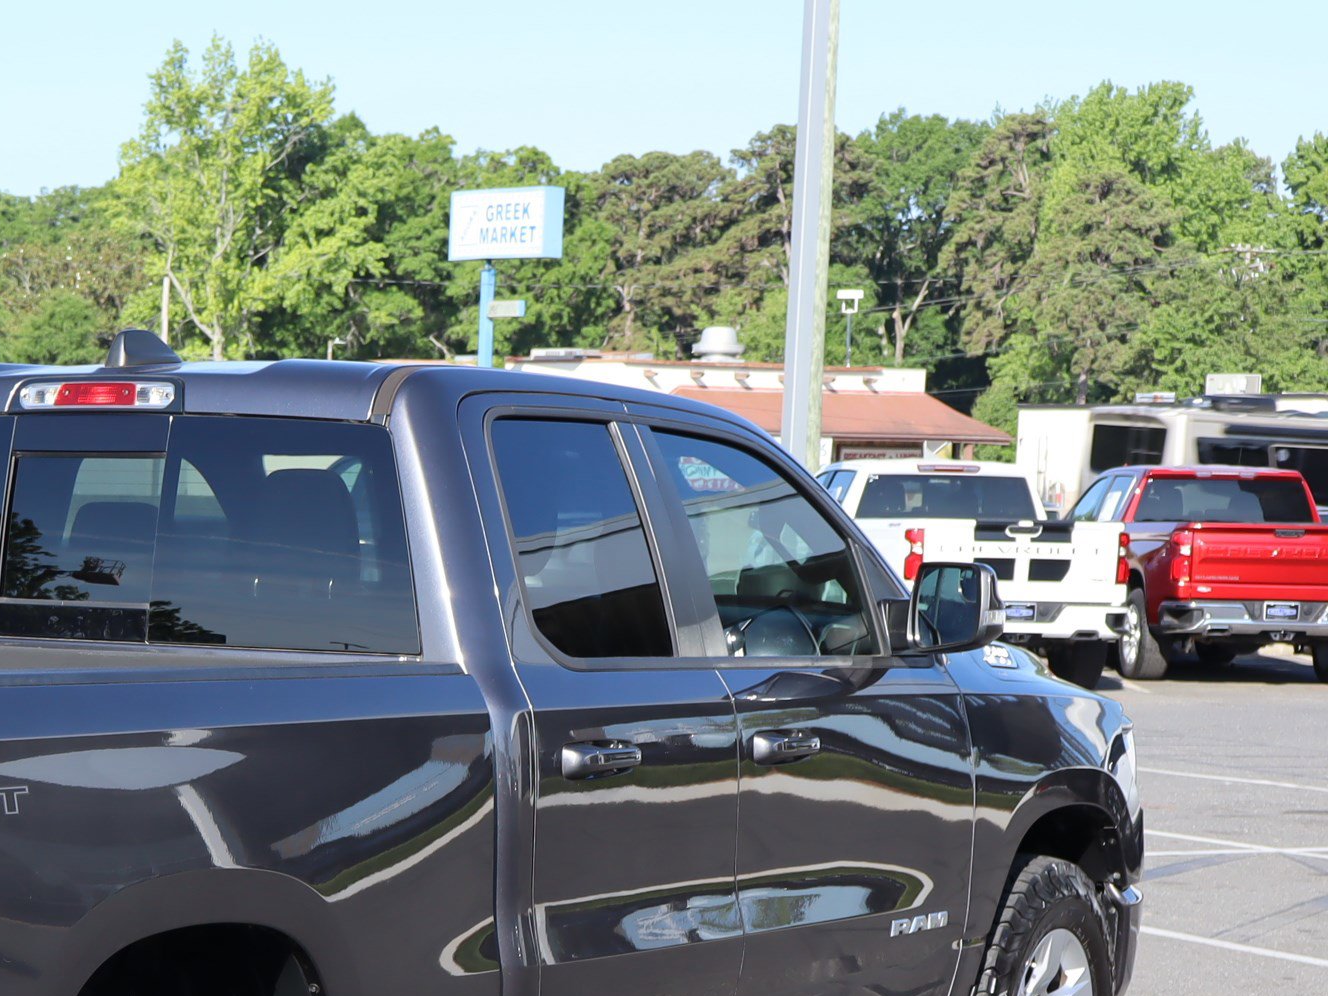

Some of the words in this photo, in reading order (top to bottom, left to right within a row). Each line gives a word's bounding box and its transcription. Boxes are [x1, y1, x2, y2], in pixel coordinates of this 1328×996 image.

[486, 202, 531, 222] GREEK
[479, 225, 536, 244] MARKET
[890, 910, 949, 938] RAM
